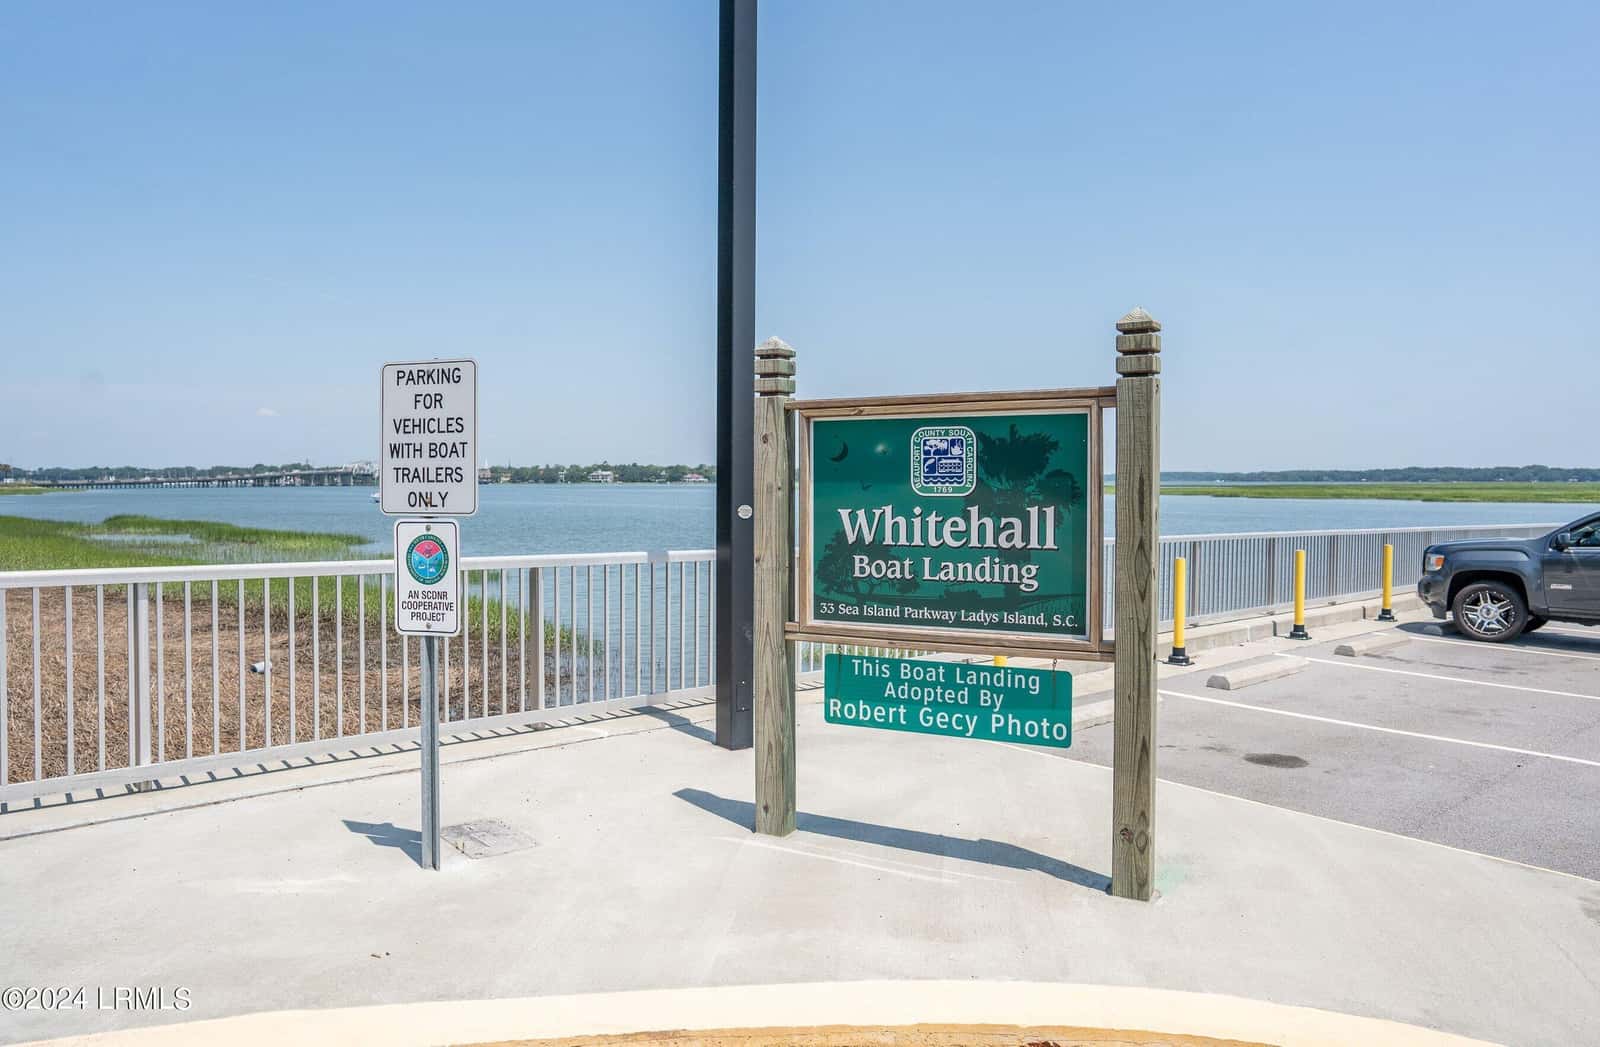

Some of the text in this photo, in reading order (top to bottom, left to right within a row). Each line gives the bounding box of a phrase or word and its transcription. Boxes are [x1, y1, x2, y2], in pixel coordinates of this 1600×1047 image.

[396, 367, 462, 386] PARKING
[414, 393, 443, 409] FOR
[393, 417, 465, 434] VEHICLES
[389, 441, 468, 459] WITH BOAT
[913, 429, 974, 489] BEAUFORT COUNTY SOUTH CAROLINA
[393, 466, 464, 483] TRAILERS
[407, 491, 449, 508] ONLY
[837, 504, 1059, 550] Whitehall
[852, 554, 1040, 592] Boat Landing
[407, 590, 448, 600] AN SCDNR
[401, 601, 455, 611] COOPERATIVE
[819, 602, 1078, 627] 33 Sea Island Parkway Ladys Island, S.C.
[410, 612, 446, 622] PROJECT
[852, 659, 1040, 694] This Boat Landing
[884, 681, 1004, 712] Adopted By
[829, 698, 1068, 741] Robert Gecy Photo
